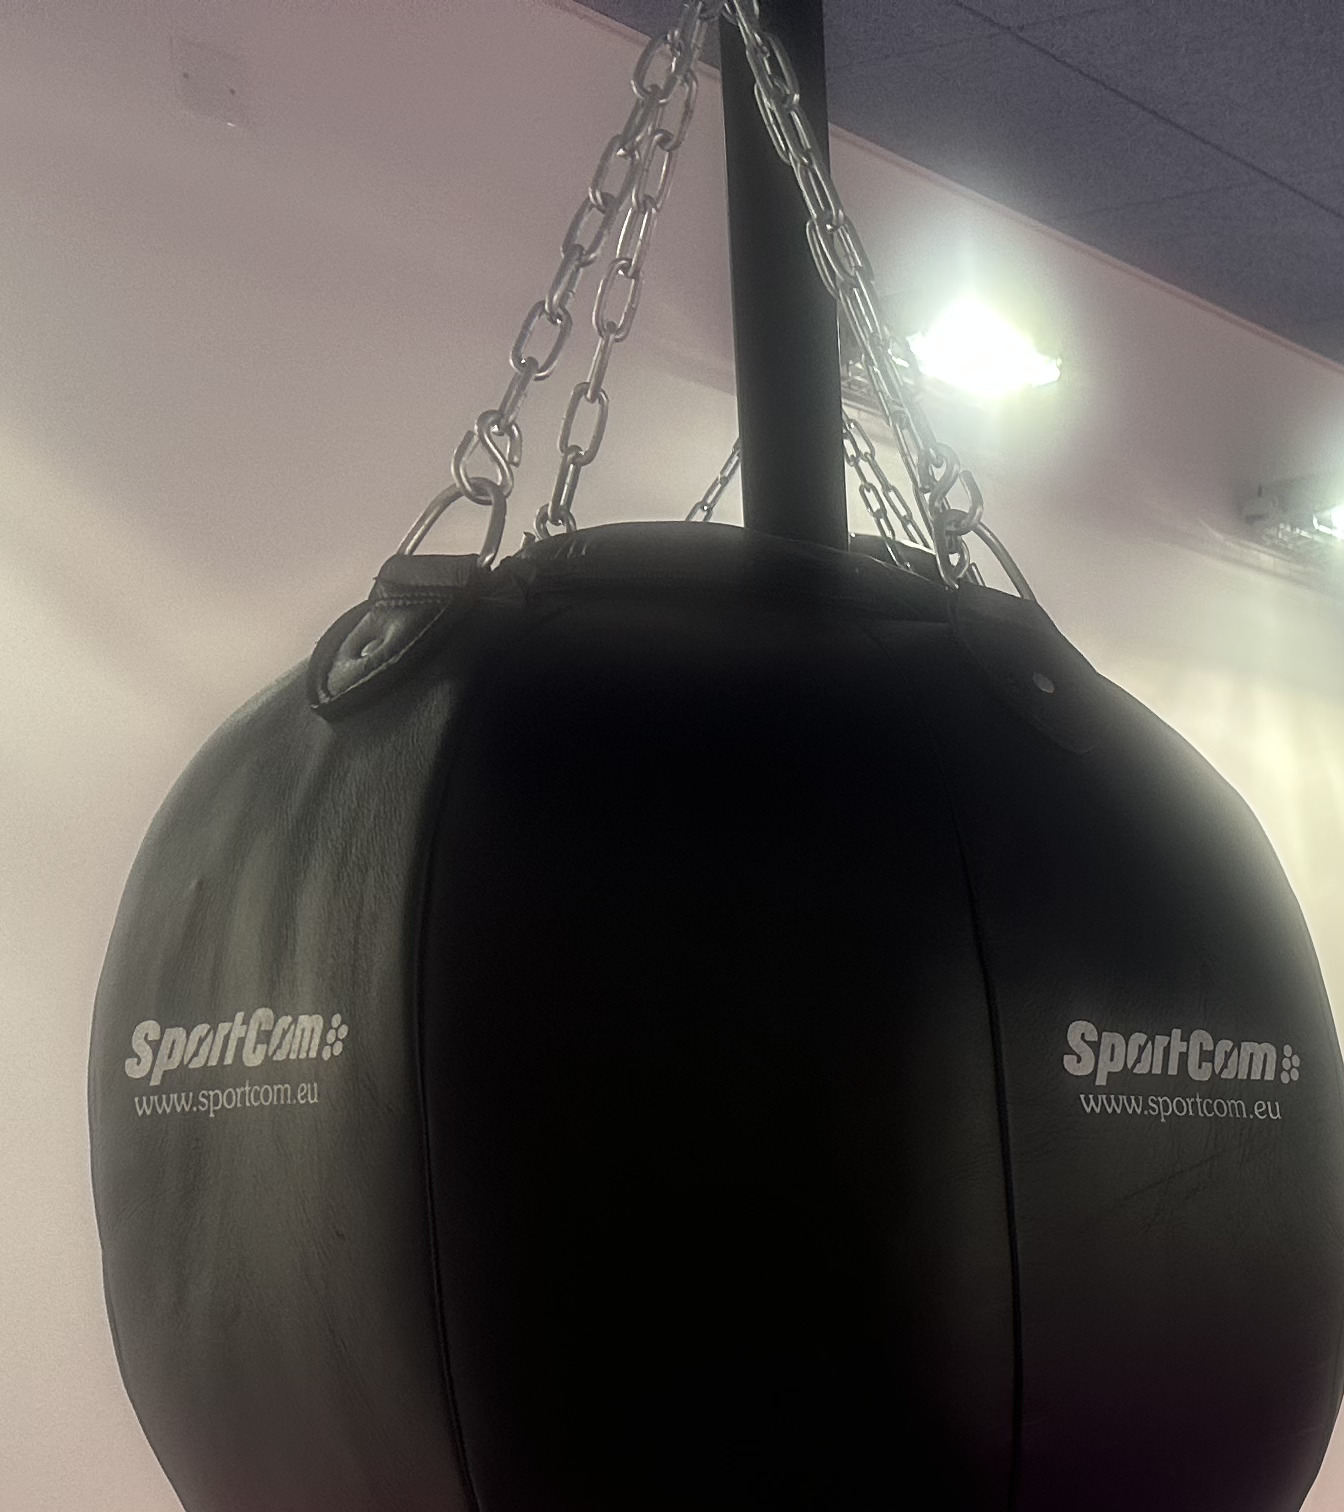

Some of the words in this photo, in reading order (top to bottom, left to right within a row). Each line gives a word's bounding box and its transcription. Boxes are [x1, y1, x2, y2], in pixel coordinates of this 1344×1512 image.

[125, 1007, 324, 1086] SportCom
[1063, 1020, 1278, 1086] SportCom
[134, 1080, 319, 1117] www.sportcom.eu
[1079, 1092, 1282, 1122] www.sportcom.eu
